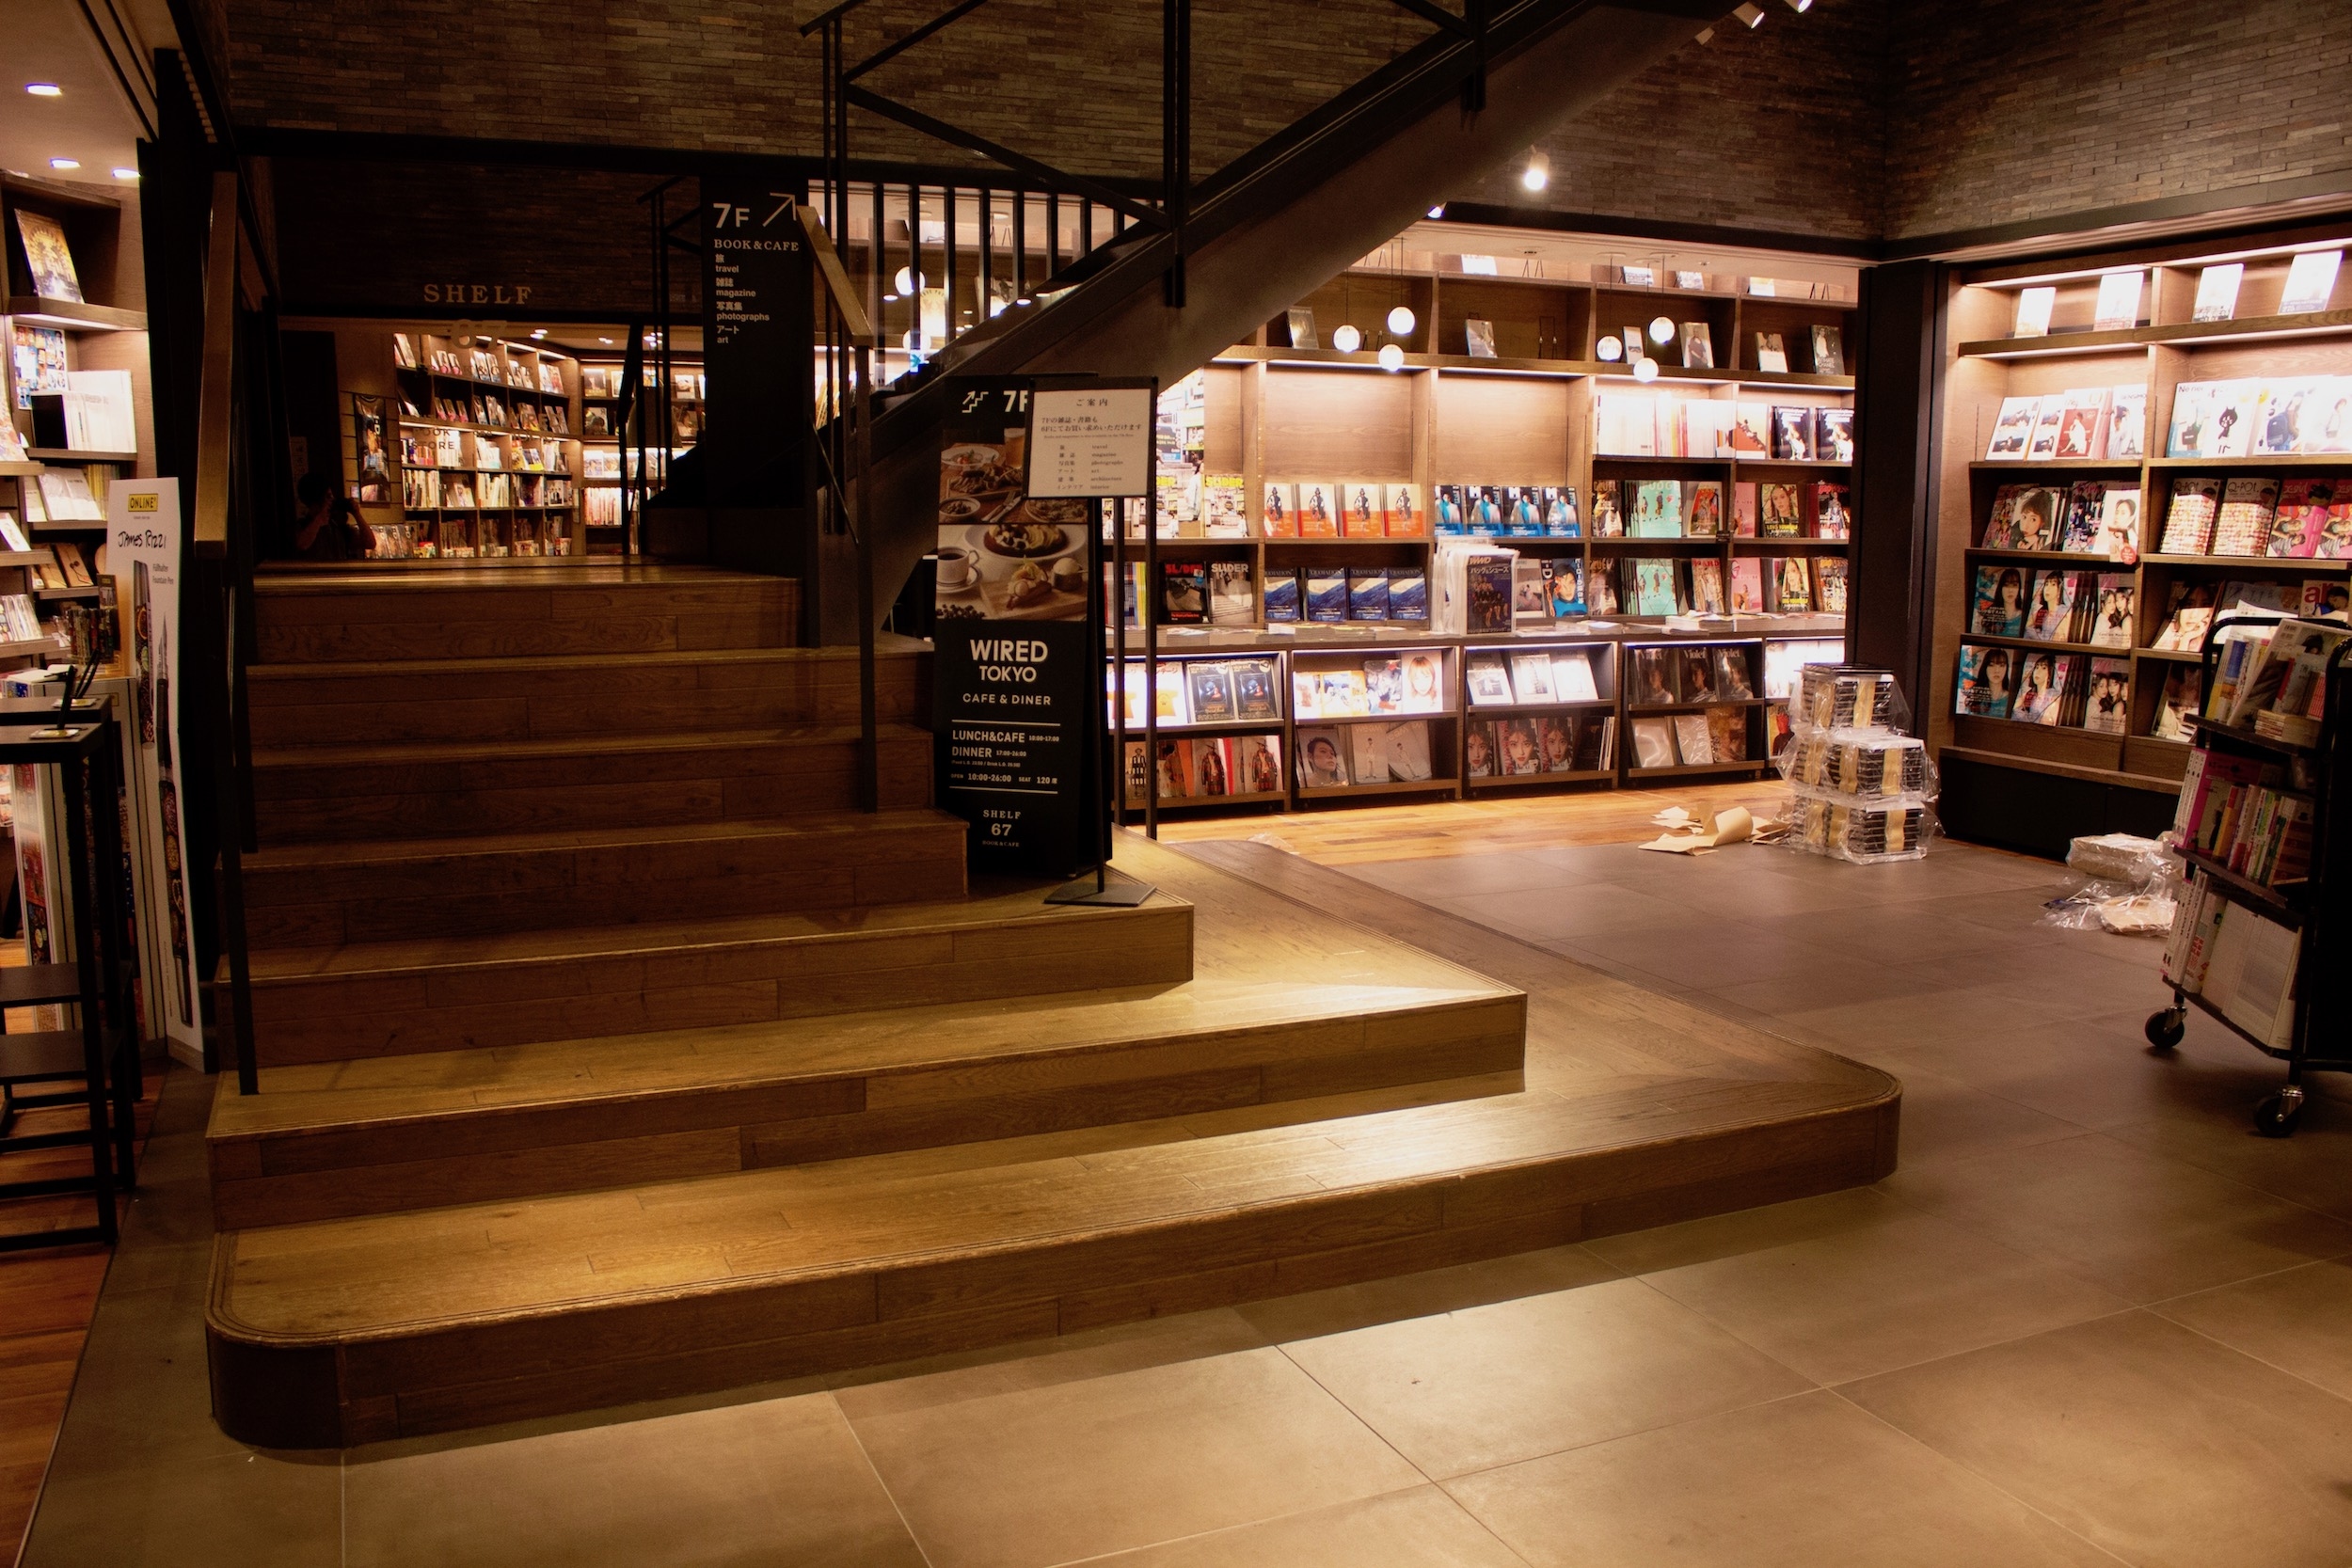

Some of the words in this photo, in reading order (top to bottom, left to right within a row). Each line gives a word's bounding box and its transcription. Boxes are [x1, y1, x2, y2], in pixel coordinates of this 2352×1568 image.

[713, 203, 750, 229] 7F
[715, 254, 724, 263] 旅
[715, 264, 739, 274] travel
[715, 277, 734, 287] 雑誌
[423, 283, 532, 305] SHELF
[715, 289, 756, 298] magazine
[716, 302, 743, 311] 写真集
[716, 311, 771, 322] photographs
[717, 325, 739, 335] アート
[717, 336, 729, 344] art
[1003, 390, 1029, 412] 7F
[1076, 398, 1108, 406] ご案内
[130, 497, 154, 509] ONLINE
[1469, 556, 1492, 565] WWD
[970, 639, 1048, 663] WIRED
[979, 665, 1037, 683] TOKYO
[962, 693, 995, 704] CAFE
[999, 694, 1008, 705] &
[1011, 695, 1051, 705] DINER
[952, 729, 1025, 743] LUNCH&CAFE
[952, 746, 993, 758] DINNER
[967, 772, 1011, 783] 10:00-26:00
[1036, 776, 1051, 784] 120
[983, 809, 1023, 820] SHELF
[991, 823, 1012, 836] 67
